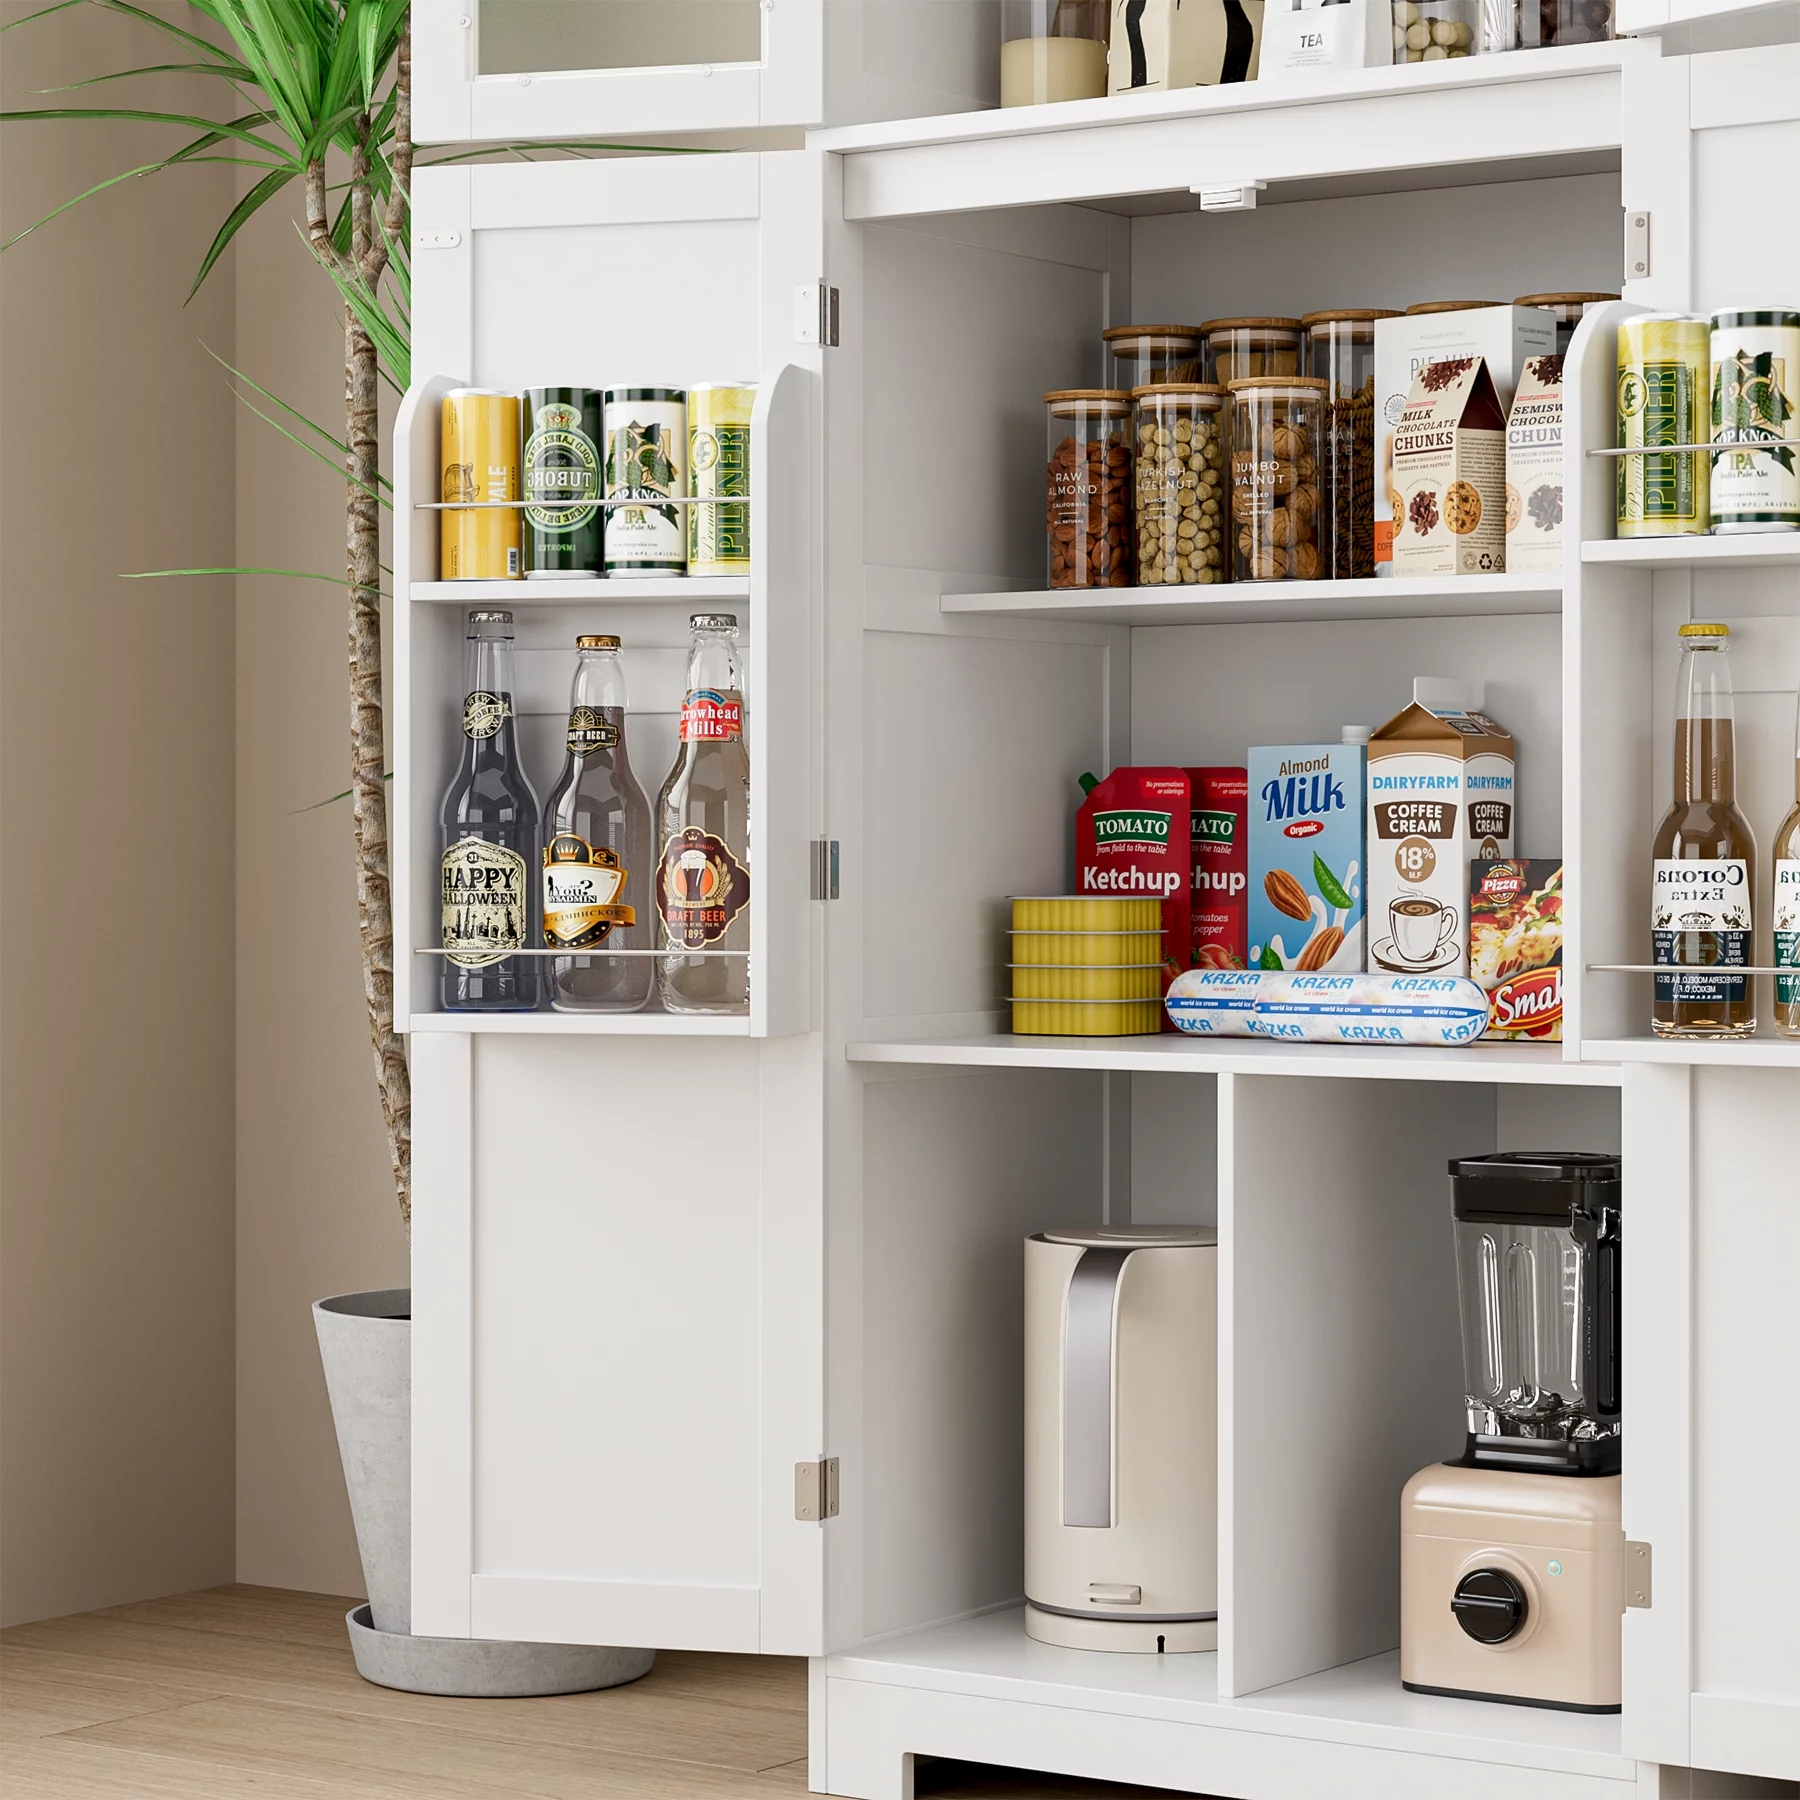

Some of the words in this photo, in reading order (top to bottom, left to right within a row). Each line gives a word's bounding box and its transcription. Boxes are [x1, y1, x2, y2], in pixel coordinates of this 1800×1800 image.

[1300, 33, 1323, 48] TEA
[1401, 409, 1434, 422] MILK
[1513, 403, 1563, 415] SEMISW
[1396, 418, 1457, 434] CHOCOLATE
[1510, 415, 1563, 427] CHOCOL
[1394, 431, 1454, 451] CHUNKS
[1508, 428, 1563, 444] CHUN
[1644, 370, 1677, 512] PILSNER
[1236, 461, 1280, 473] JUMBO
[1730, 453, 1756, 471] IPA
[1056, 472, 1082, 482] RAW
[1139, 467, 1186, 478] TURKISH
[1737, 470, 1753, 478] Pale
[1755, 470, 1768, 478] Ale
[488, 465, 507, 502] ALE
[1234, 474, 1285, 487] WALNUT
[717, 431, 744, 555] PILSNER
[1048, 485, 1097, 496] ALMOND
[1242, 491, 1269, 499] SHELLED
[624, 510, 647, 524] IPA
[1376, 542, 1393, 551] COFF
[681, 705, 739, 720] rrowhead
[471, 717, 500, 737] BREW
[687, 720, 723, 736] Mills
[586, 730, 606, 740] BEER
[1279, 753, 1330, 777] Almond
[1153, 781, 1185, 789] preservatives
[1218, 781, 1248, 789] preservative
[1372, 775, 1459, 790] DAIRYFARM
[1467, 776, 1512, 790] DAIRYFARM
[1163, 788, 1185, 796] colorings
[1228, 788, 1248, 796] coloring
[1261, 772, 1346, 822] Milk
[1387, 804, 1443, 819] COFFEE
[1474, 804, 1504, 819] COFFEE
[1096, 818, 1168, 836] TOMATO
[1190, 818, 1233, 836] ATO
[1289, 823, 1318, 836] Organic
[1389, 819, 1442, 833] CREAM
[1475, 819, 1504, 833] CREAM
[674, 843, 693, 851] PREMIUM
[695, 843, 715, 851] QUALITY
[1096, 846, 1111, 856] from
[1111, 844, 1126, 855] field
[1127, 844, 1134, 852] to
[1135, 844, 1147, 852] the
[1148, 845, 1167, 855] table
[1192, 844, 1199, 852] to
[1200, 844, 1212, 852] the
[1213, 845, 1232, 855] table
[468, 853, 478, 861] 31
[1398, 846, 1434, 870] 18%
[443, 868, 517, 891] HAPPY
[1083, 865, 1181, 896] Ketchup
[1483, 879, 1518, 892] Pizza
[443, 892, 518, 906] HALLOWEEN
[548, 895, 598, 903] SYSADMIN
[667, 910, 694, 922] DRAFT
[700, 910, 726, 922] BEER
[684, 929, 704, 939] 1895
[1193, 925, 1224, 936] pepper
[1200, 972, 1262, 985] KAZKA
[1291, 976, 1355, 989] KAZKA
[1391, 978, 1457, 992] KAZKA
[1170, 1015, 1213, 1031] AZKA
[1259, 1019, 1305, 1037] AZKA
[1339, 1025, 1404, 1040] KAZKA
